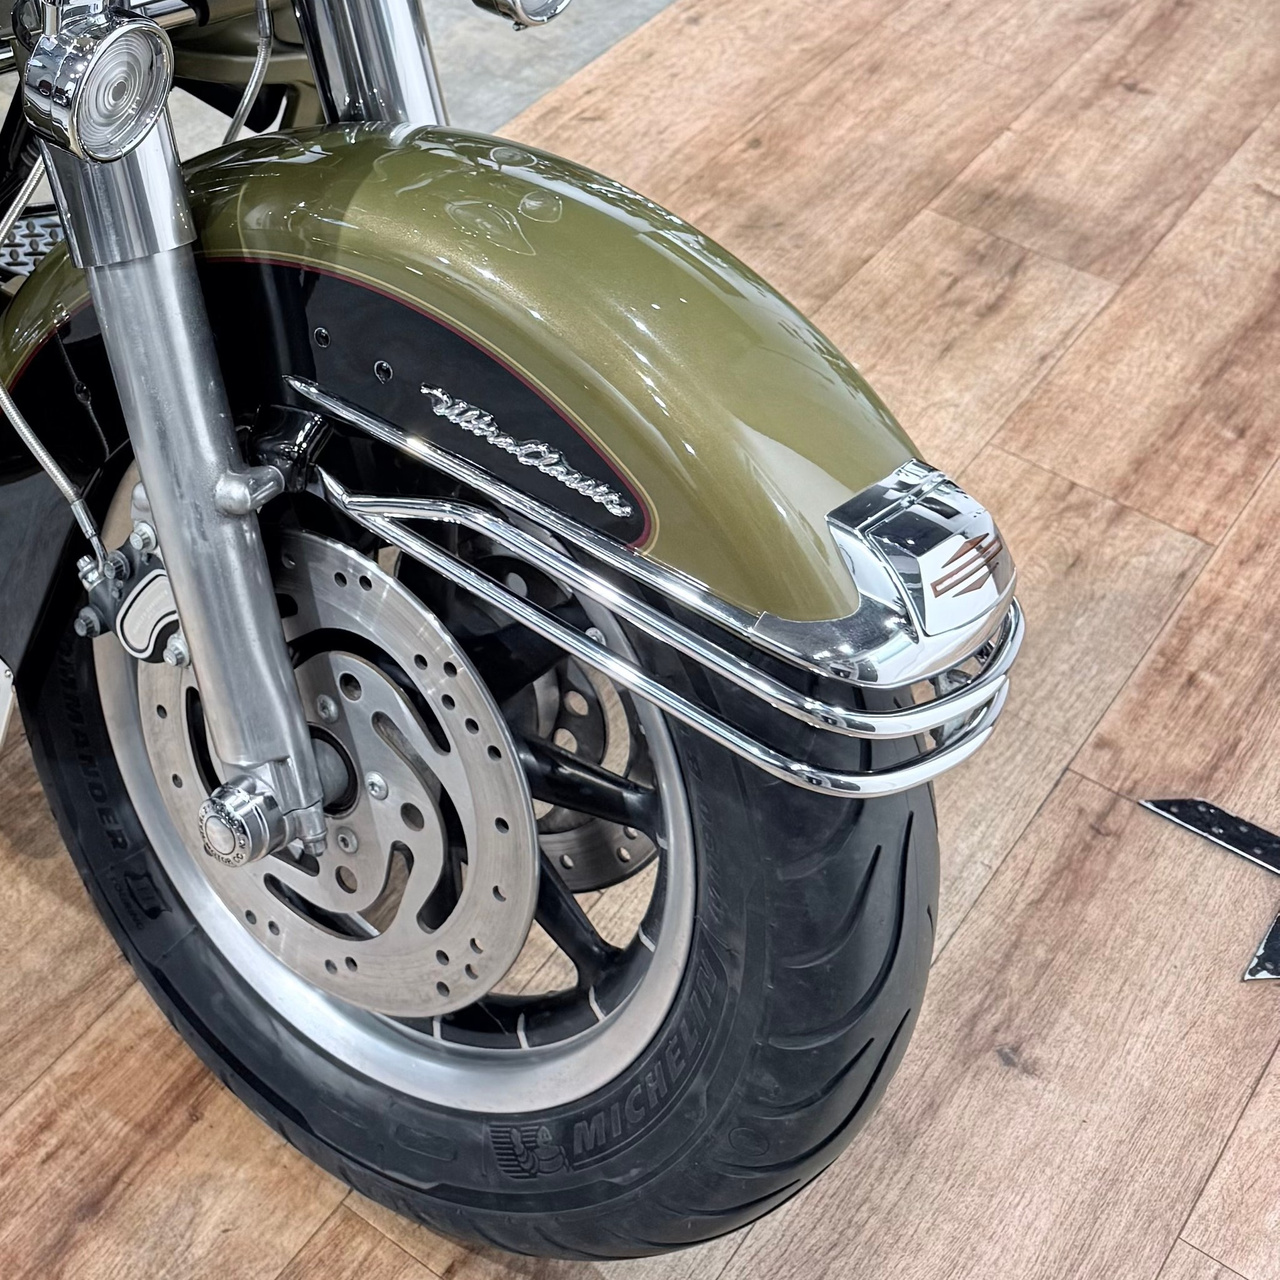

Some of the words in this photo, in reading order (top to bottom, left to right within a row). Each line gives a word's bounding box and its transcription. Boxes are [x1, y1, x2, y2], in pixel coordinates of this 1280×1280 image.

[420, 381, 520, 456] Ultra
[517, 439, 634, 518] Classic
[573, 949, 718, 1156] MICHELIN
